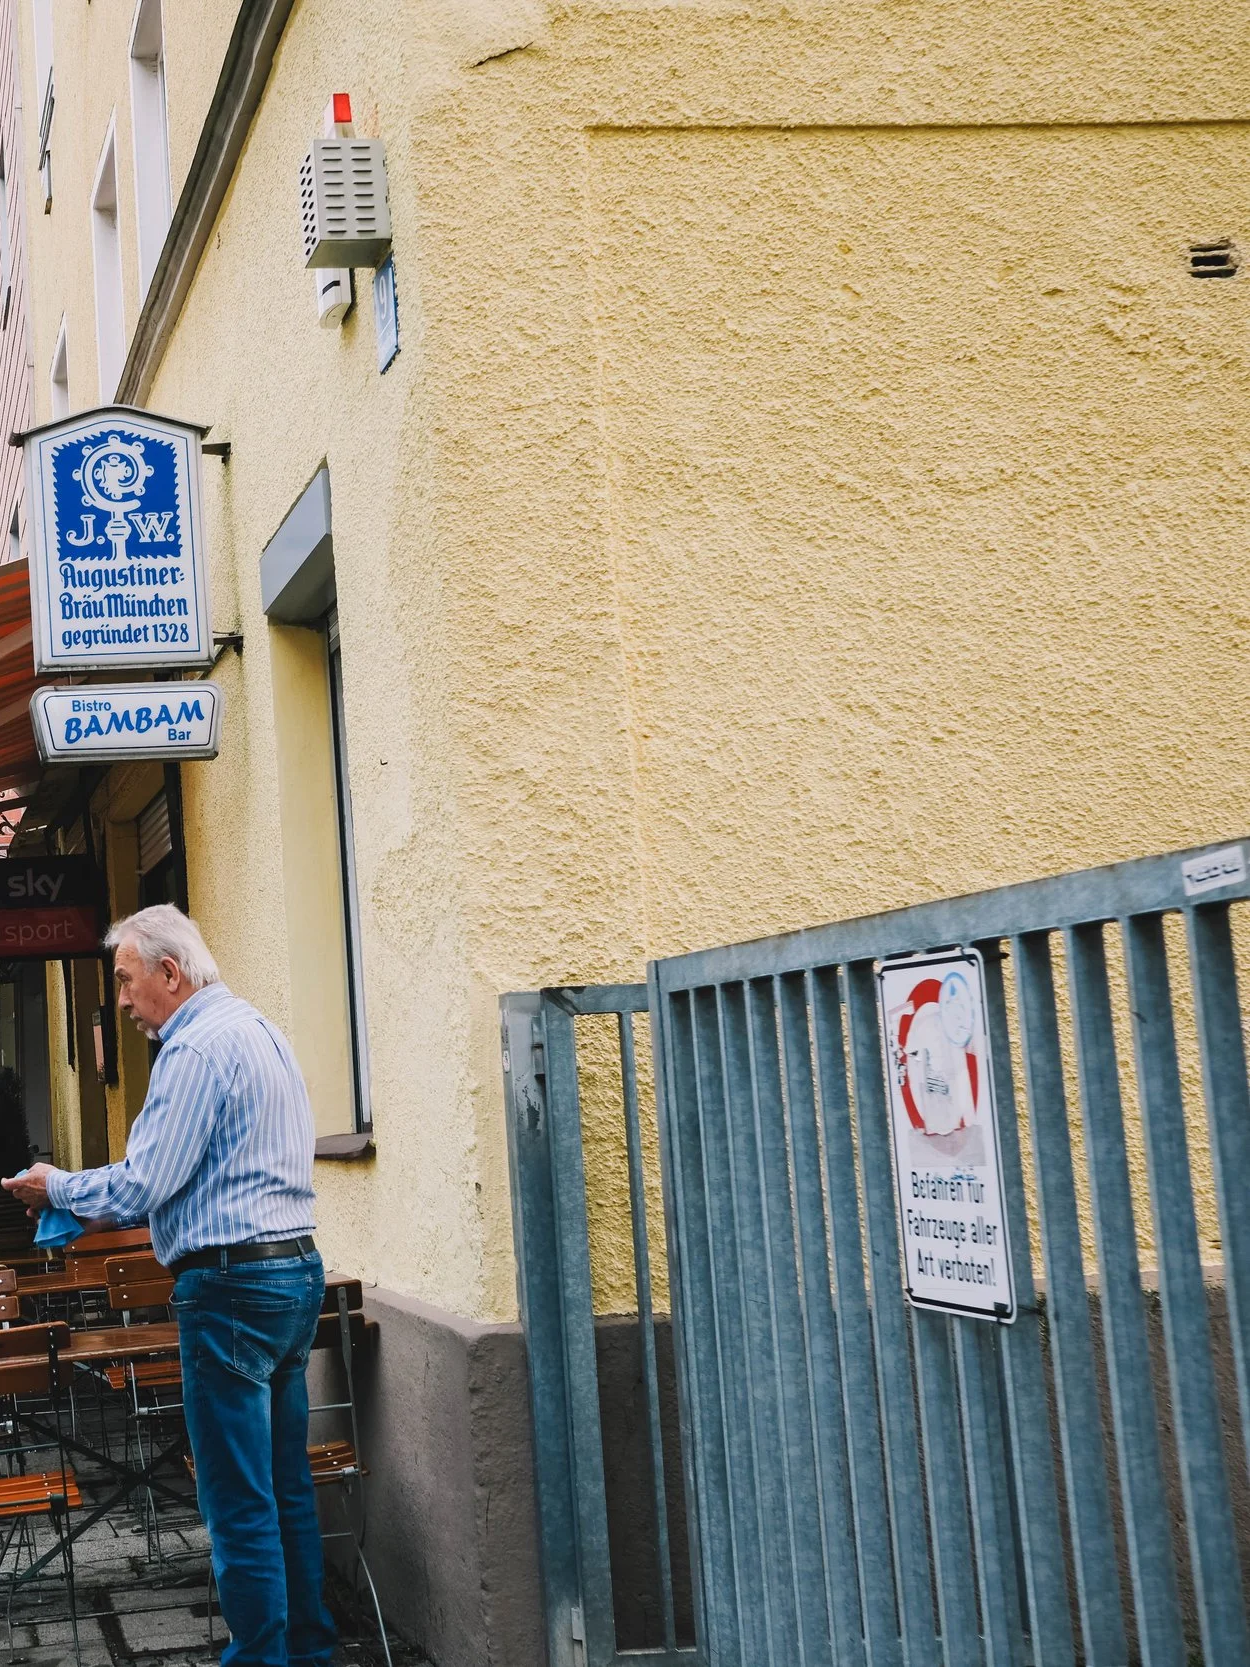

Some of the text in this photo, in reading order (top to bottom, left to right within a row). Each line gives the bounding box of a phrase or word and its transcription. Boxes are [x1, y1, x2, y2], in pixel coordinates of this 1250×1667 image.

[128, 512, 175, 543] W.
[62, 622, 190, 649] gegründet 1328
[72, 700, 111, 712] Bistro
[64, 700, 204, 744] BAMBAM
[168, 728, 191, 741] Bar
[7, 867, 65, 902] sky
[5, 919, 74, 946] sport
[907, 1208, 997, 1249] Fahrzeuge aller
[917, 1248, 935, 1277] Art
